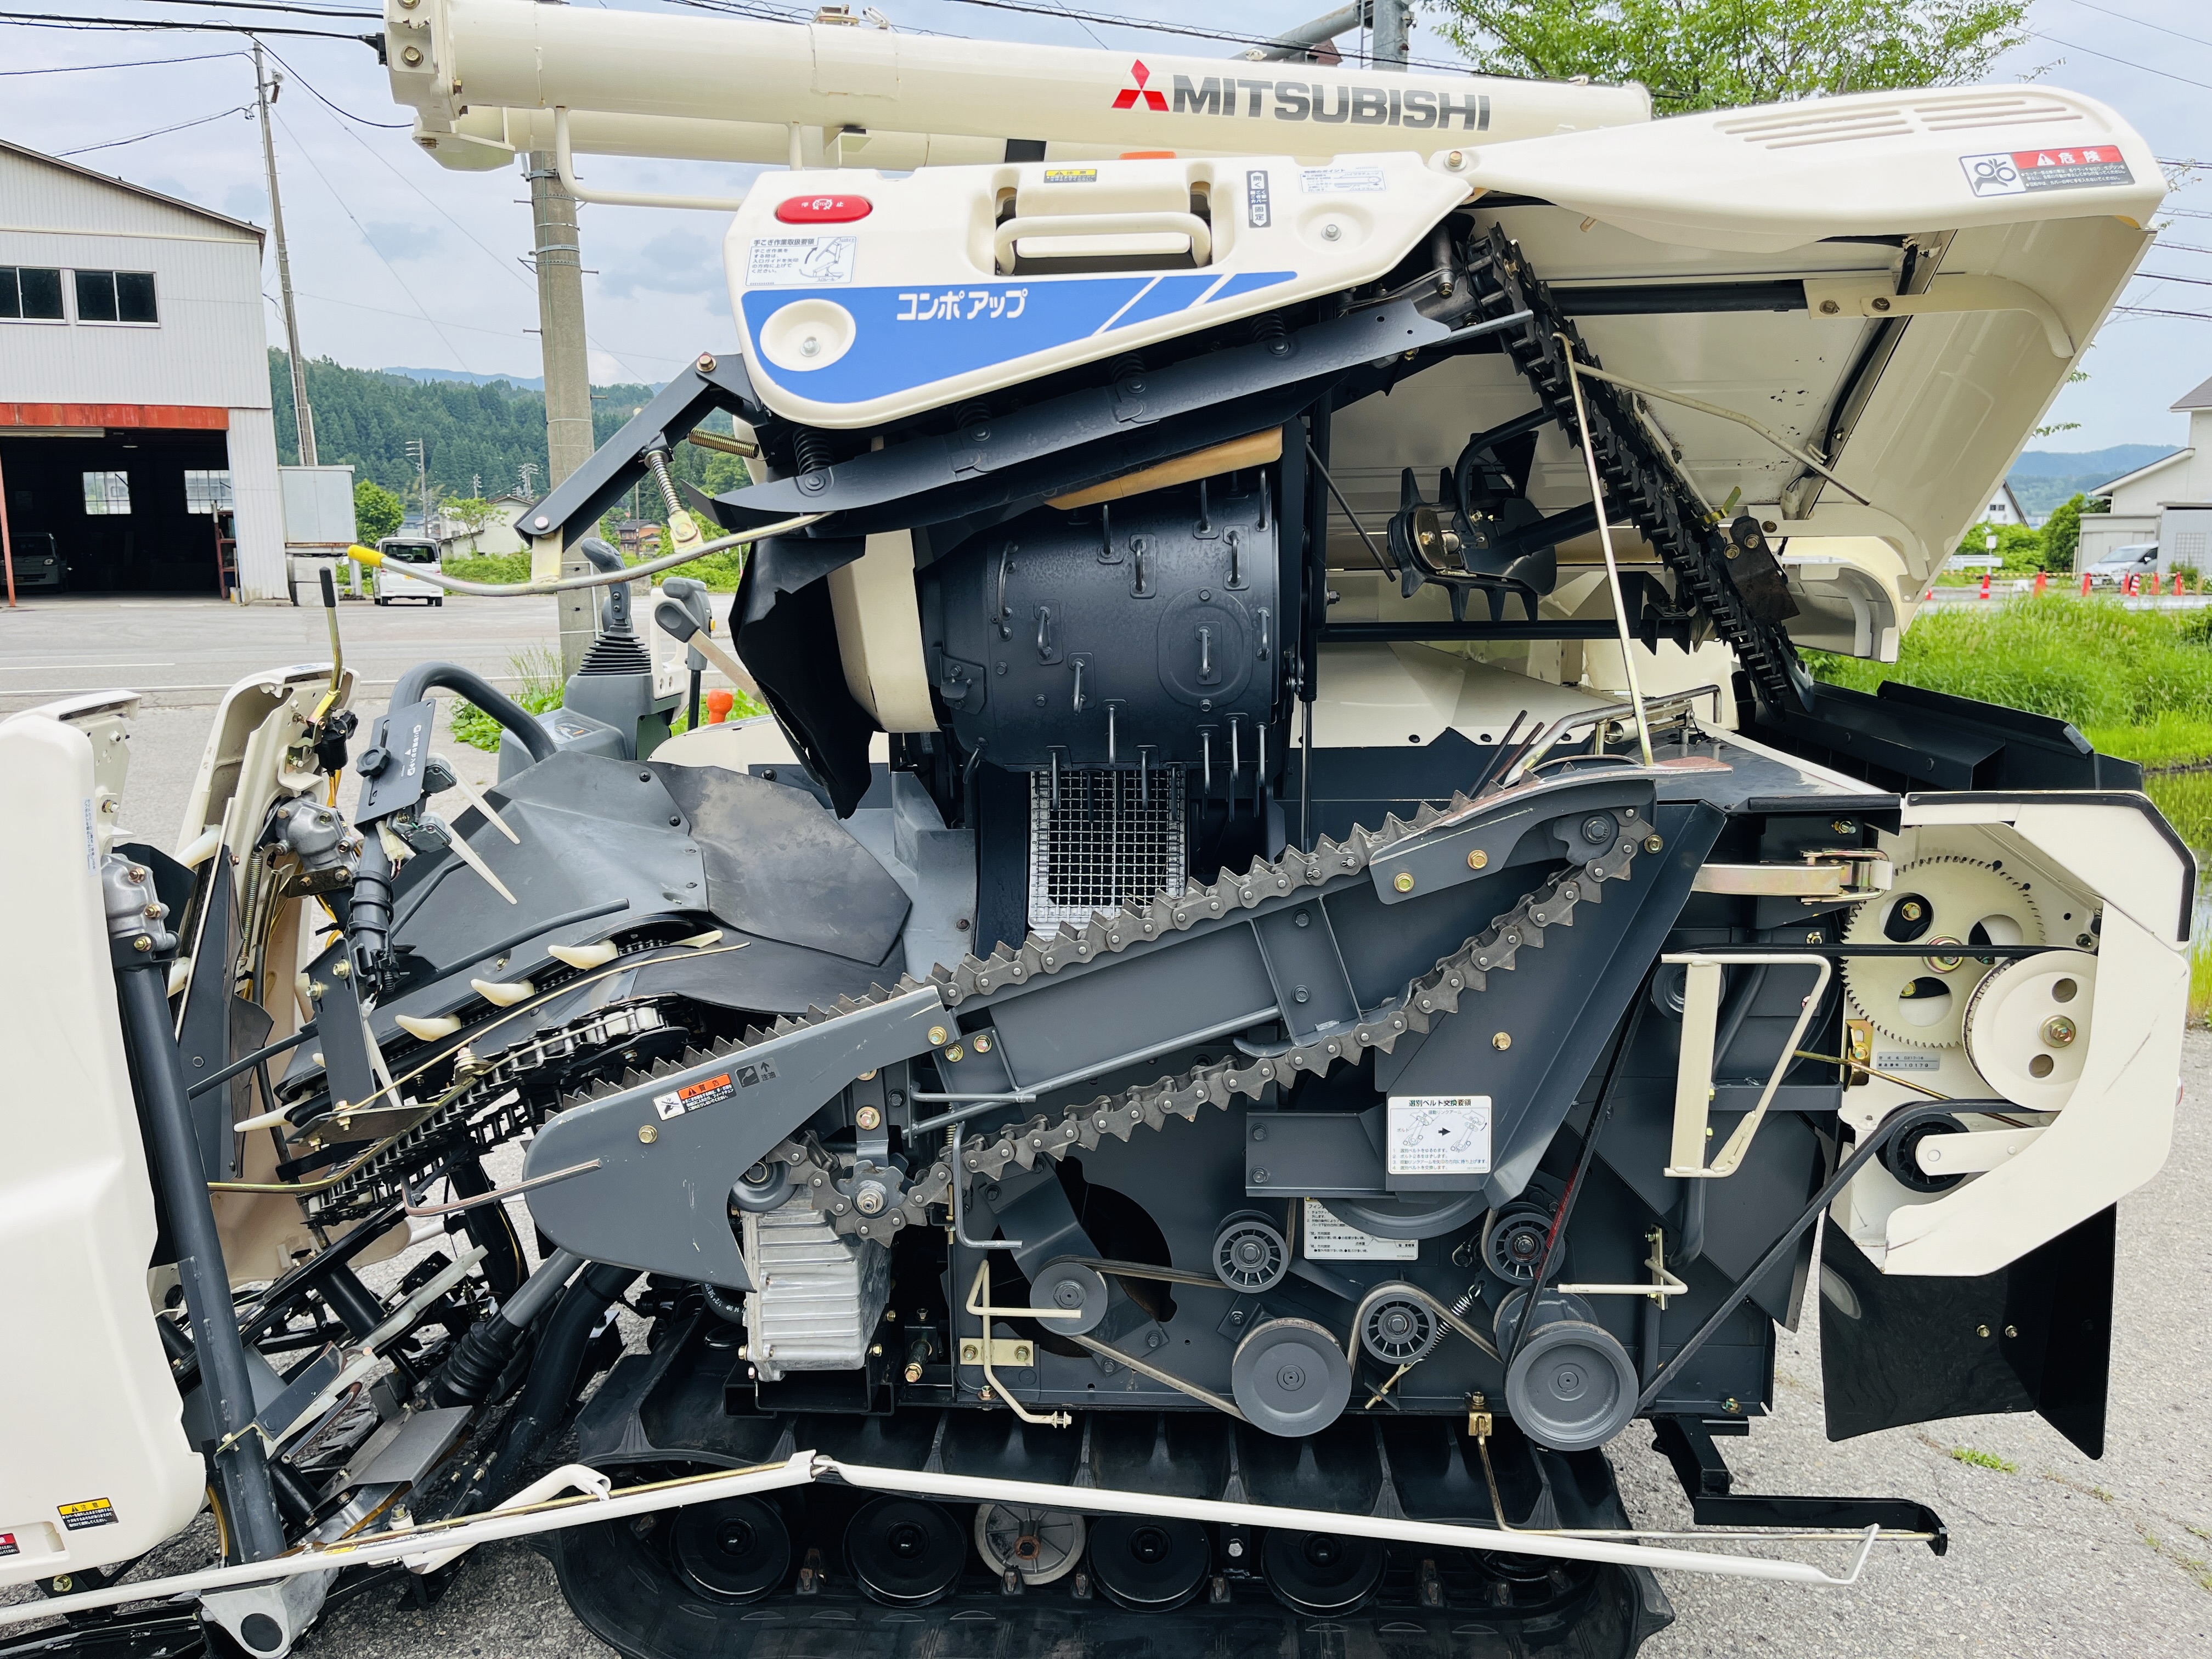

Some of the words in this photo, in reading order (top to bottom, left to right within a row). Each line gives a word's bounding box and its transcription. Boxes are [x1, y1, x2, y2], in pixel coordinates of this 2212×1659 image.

[1173, 75, 1490, 131] MITSUBISHI
[2057, 150, 2101, 164] 危険
[1253, 176, 1262, 188] 開く
[1255, 206, 1265, 221] 固定
[754, 238, 815, 246] 手こぎ作業取扱要領
[896, 287, 1029, 320] コンポアップ
[760, 1071, 776, 1081] 注油
[698, 1080, 720, 1091] 警告
[1408, 1099, 1471, 1107] 選別ベルト交換要領
[80, 1502, 99, 1510] 注意
